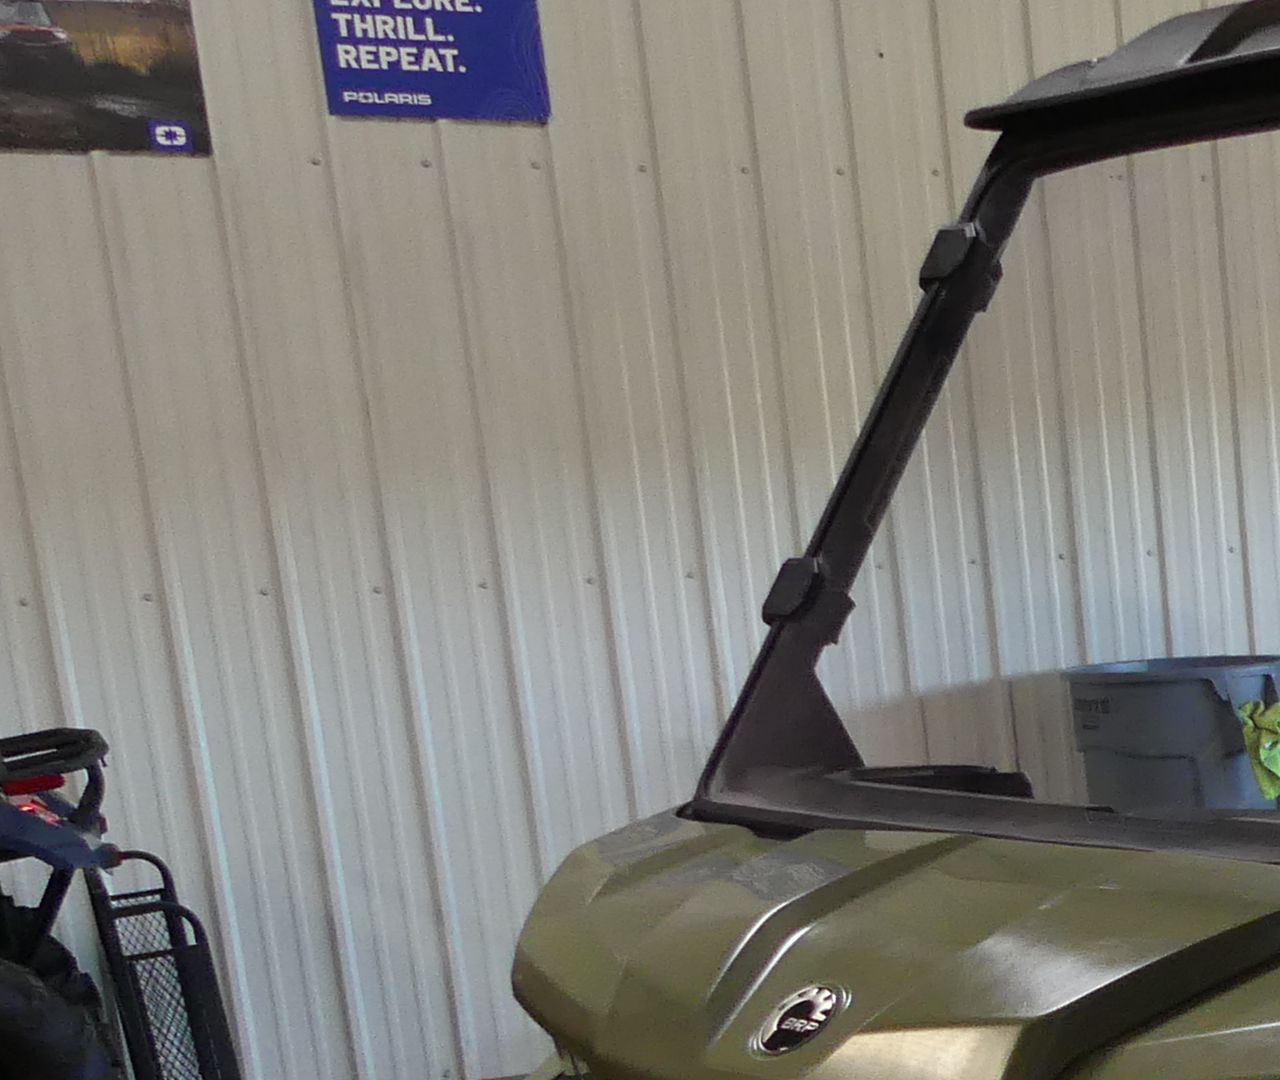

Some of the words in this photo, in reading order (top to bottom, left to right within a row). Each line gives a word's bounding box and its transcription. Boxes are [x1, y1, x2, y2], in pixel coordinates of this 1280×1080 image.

[330, 12, 455, 42] THRILL.
[336, 43, 467, 73] REPEAT.
[343, 91, 432, 106] POLARIS
[781, 1017, 819, 1033] BRP
